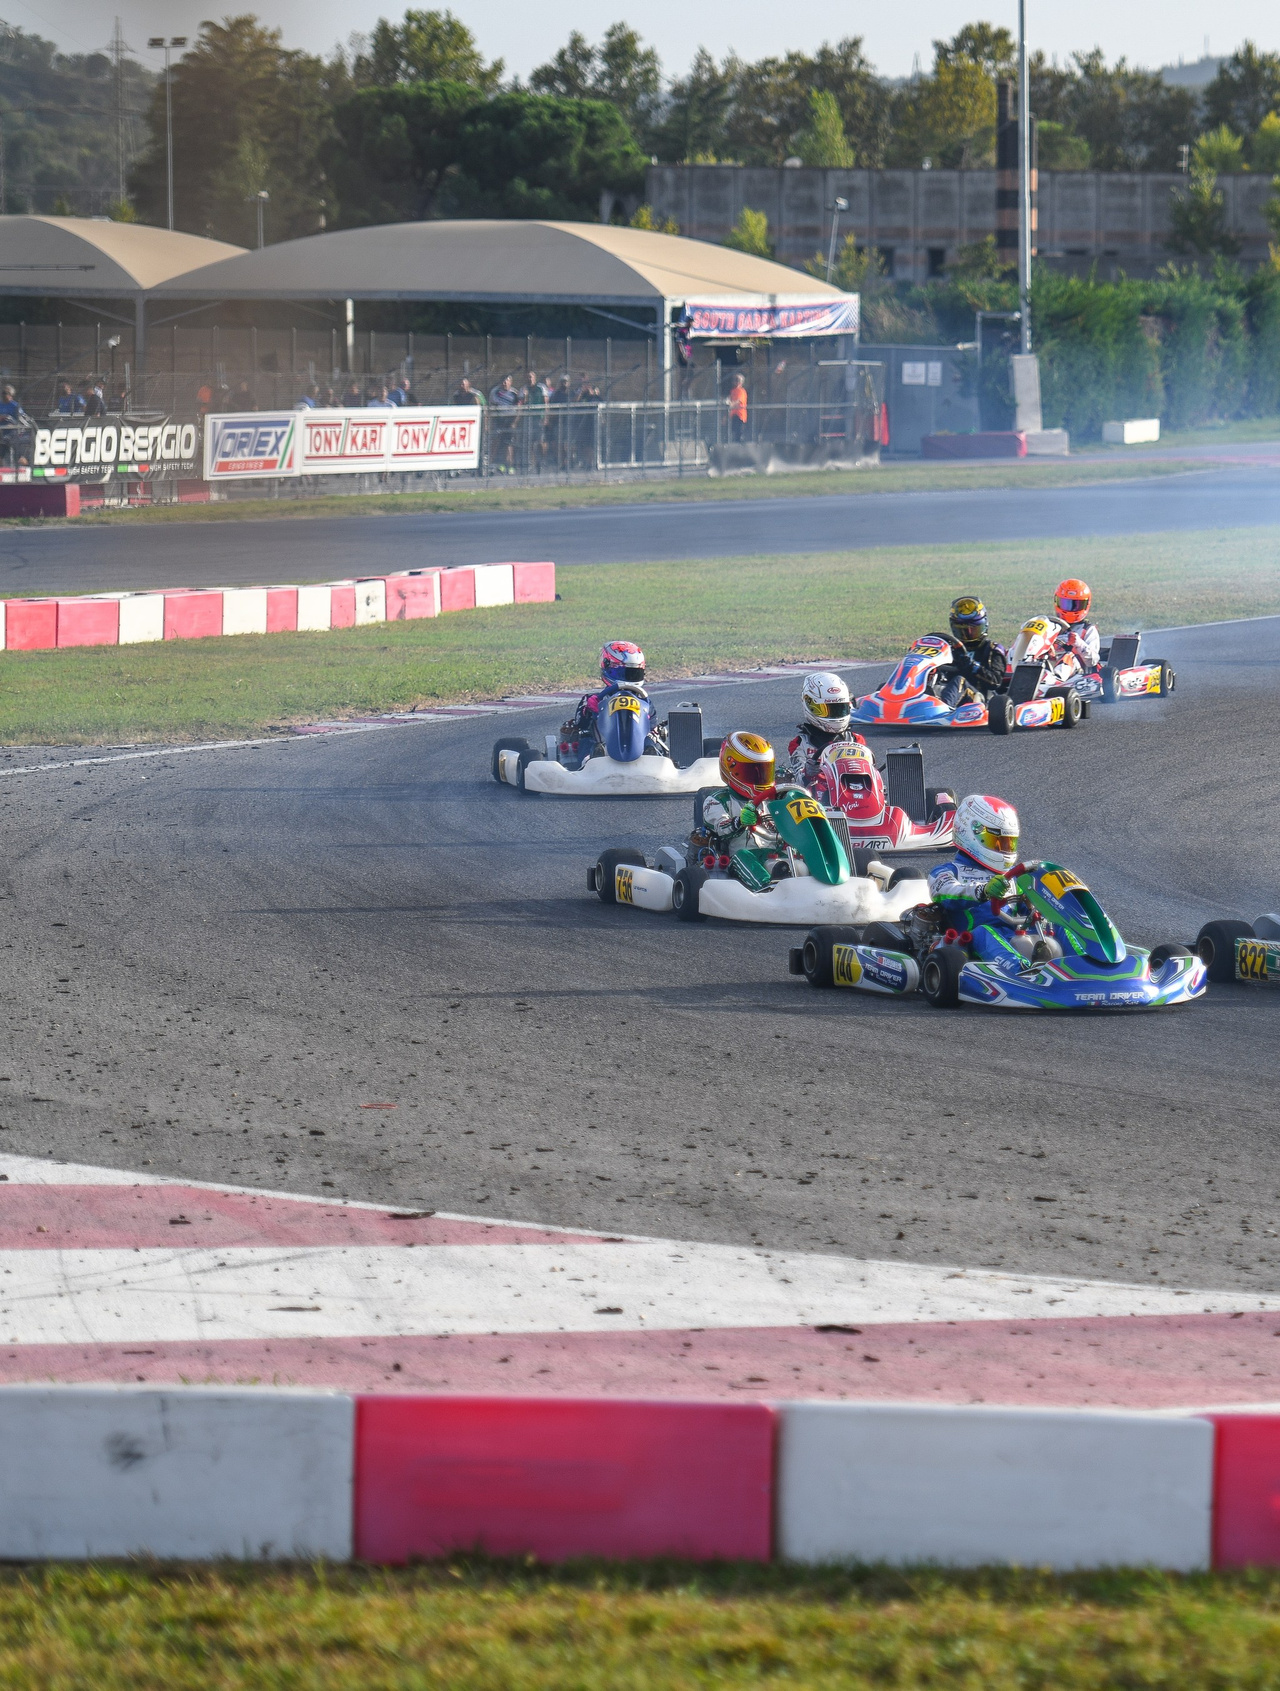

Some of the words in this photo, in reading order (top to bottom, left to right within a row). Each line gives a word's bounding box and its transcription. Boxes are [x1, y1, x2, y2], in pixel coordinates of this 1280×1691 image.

[693, 310, 735, 331] SOUTH
[34, 426, 118, 465] BENGIO
[119, 424, 196, 462] BENGIO
[305, 422, 342, 454] TONY
[350, 422, 387, 454] KART
[393, 421, 430, 452] TONY
[438, 420, 476, 450] KART
[80, 465, 100, 475] SAFETY
[149, 464, 161, 472] HIGH
[162, 463, 180, 471] SAFETY
[181, 462, 194, 470] TECH
[617, 869, 633, 903] 756
[1049, 870, 1082, 888] 74
[836, 946, 853, 983] 748
[864, 962, 879, 974] TEAM
[880, 970, 903, 983] DRIVER
[1240, 944, 1269, 981] 822
[1074, 993, 1106, 1001] TEAM
[1109, 991, 1145, 1001] DRIVER
